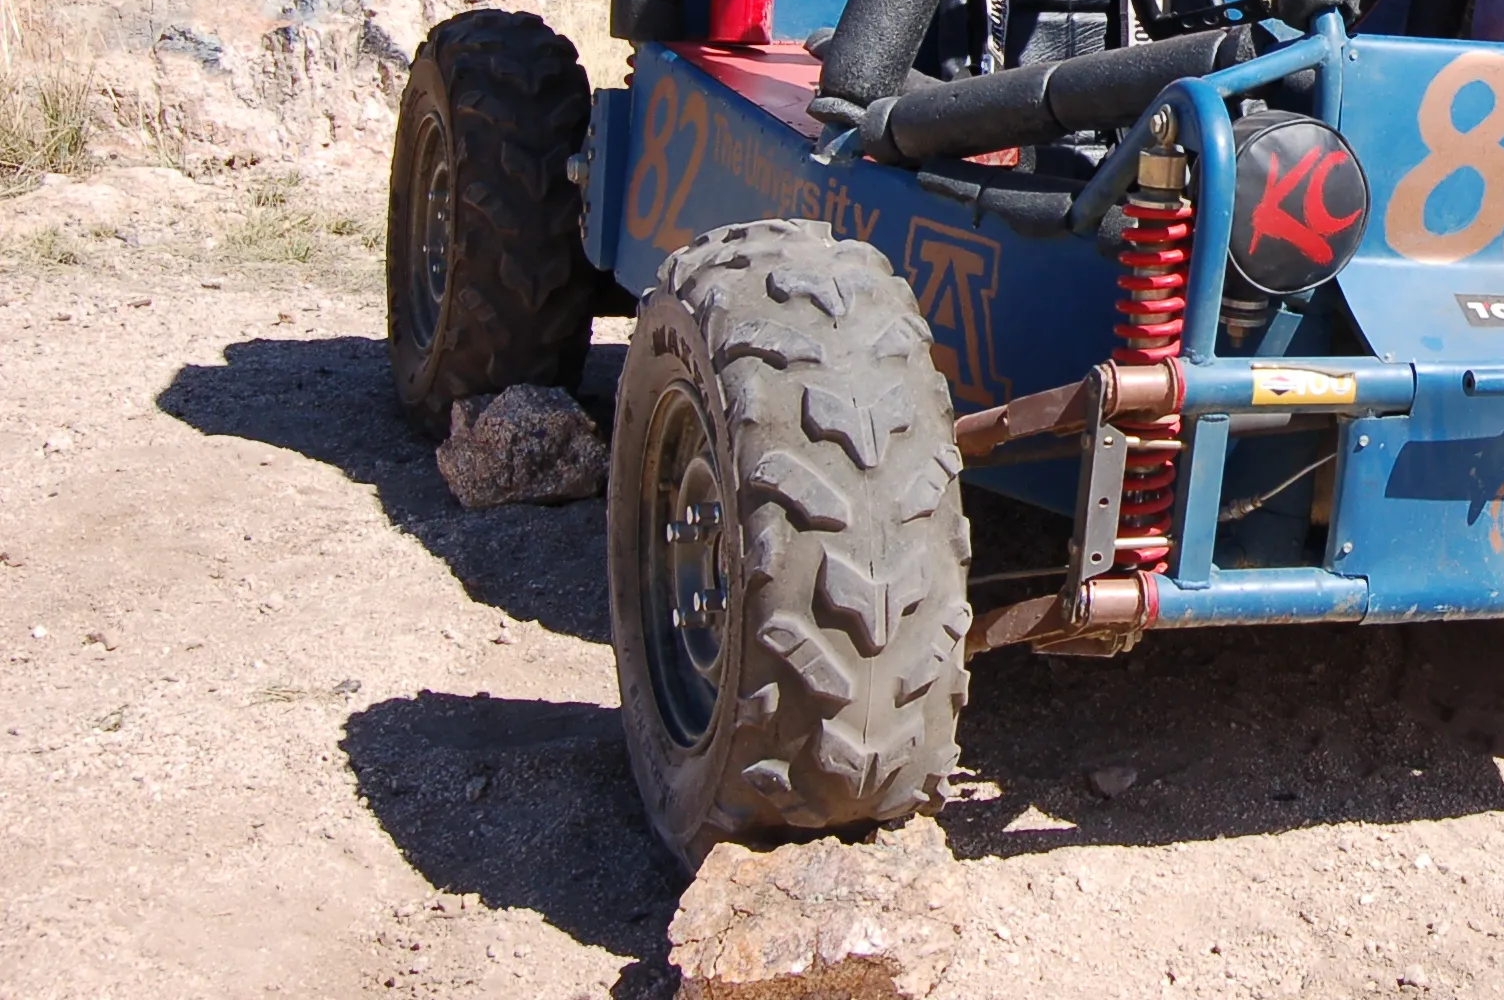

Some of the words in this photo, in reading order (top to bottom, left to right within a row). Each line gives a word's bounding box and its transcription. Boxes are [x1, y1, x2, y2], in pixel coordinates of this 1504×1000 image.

[626, 76, 709, 254] 82
[713, 112, 743, 177] The
[744, 140, 880, 242] University
[1249, 144, 1363, 266] KC
[1295, 371, 1352, 395] 100
